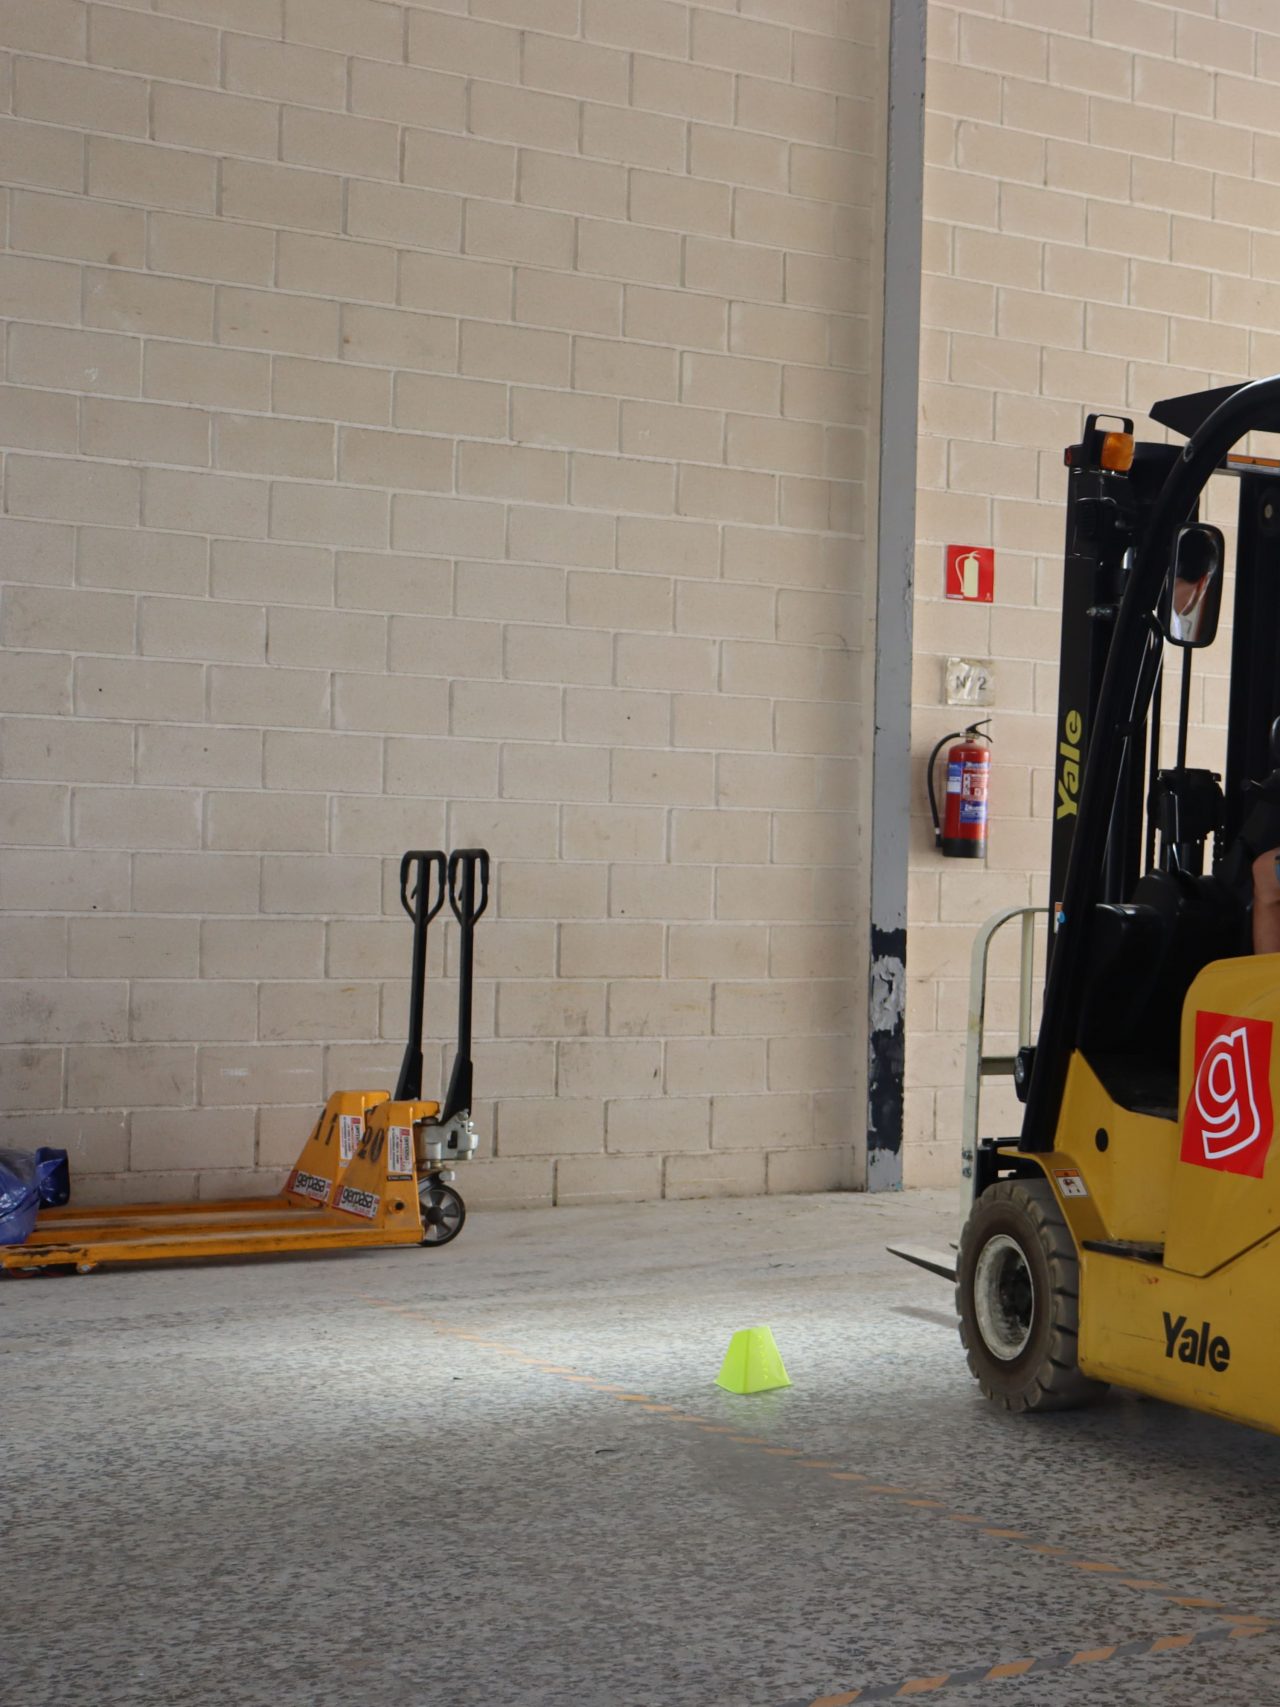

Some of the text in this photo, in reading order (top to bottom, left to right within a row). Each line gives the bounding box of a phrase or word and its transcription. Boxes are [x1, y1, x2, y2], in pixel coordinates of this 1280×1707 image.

[977, 675, 988, 691] 2
[1057, 709, 1082, 820] Yale
[1162, 1311, 1230, 1372] Yale
